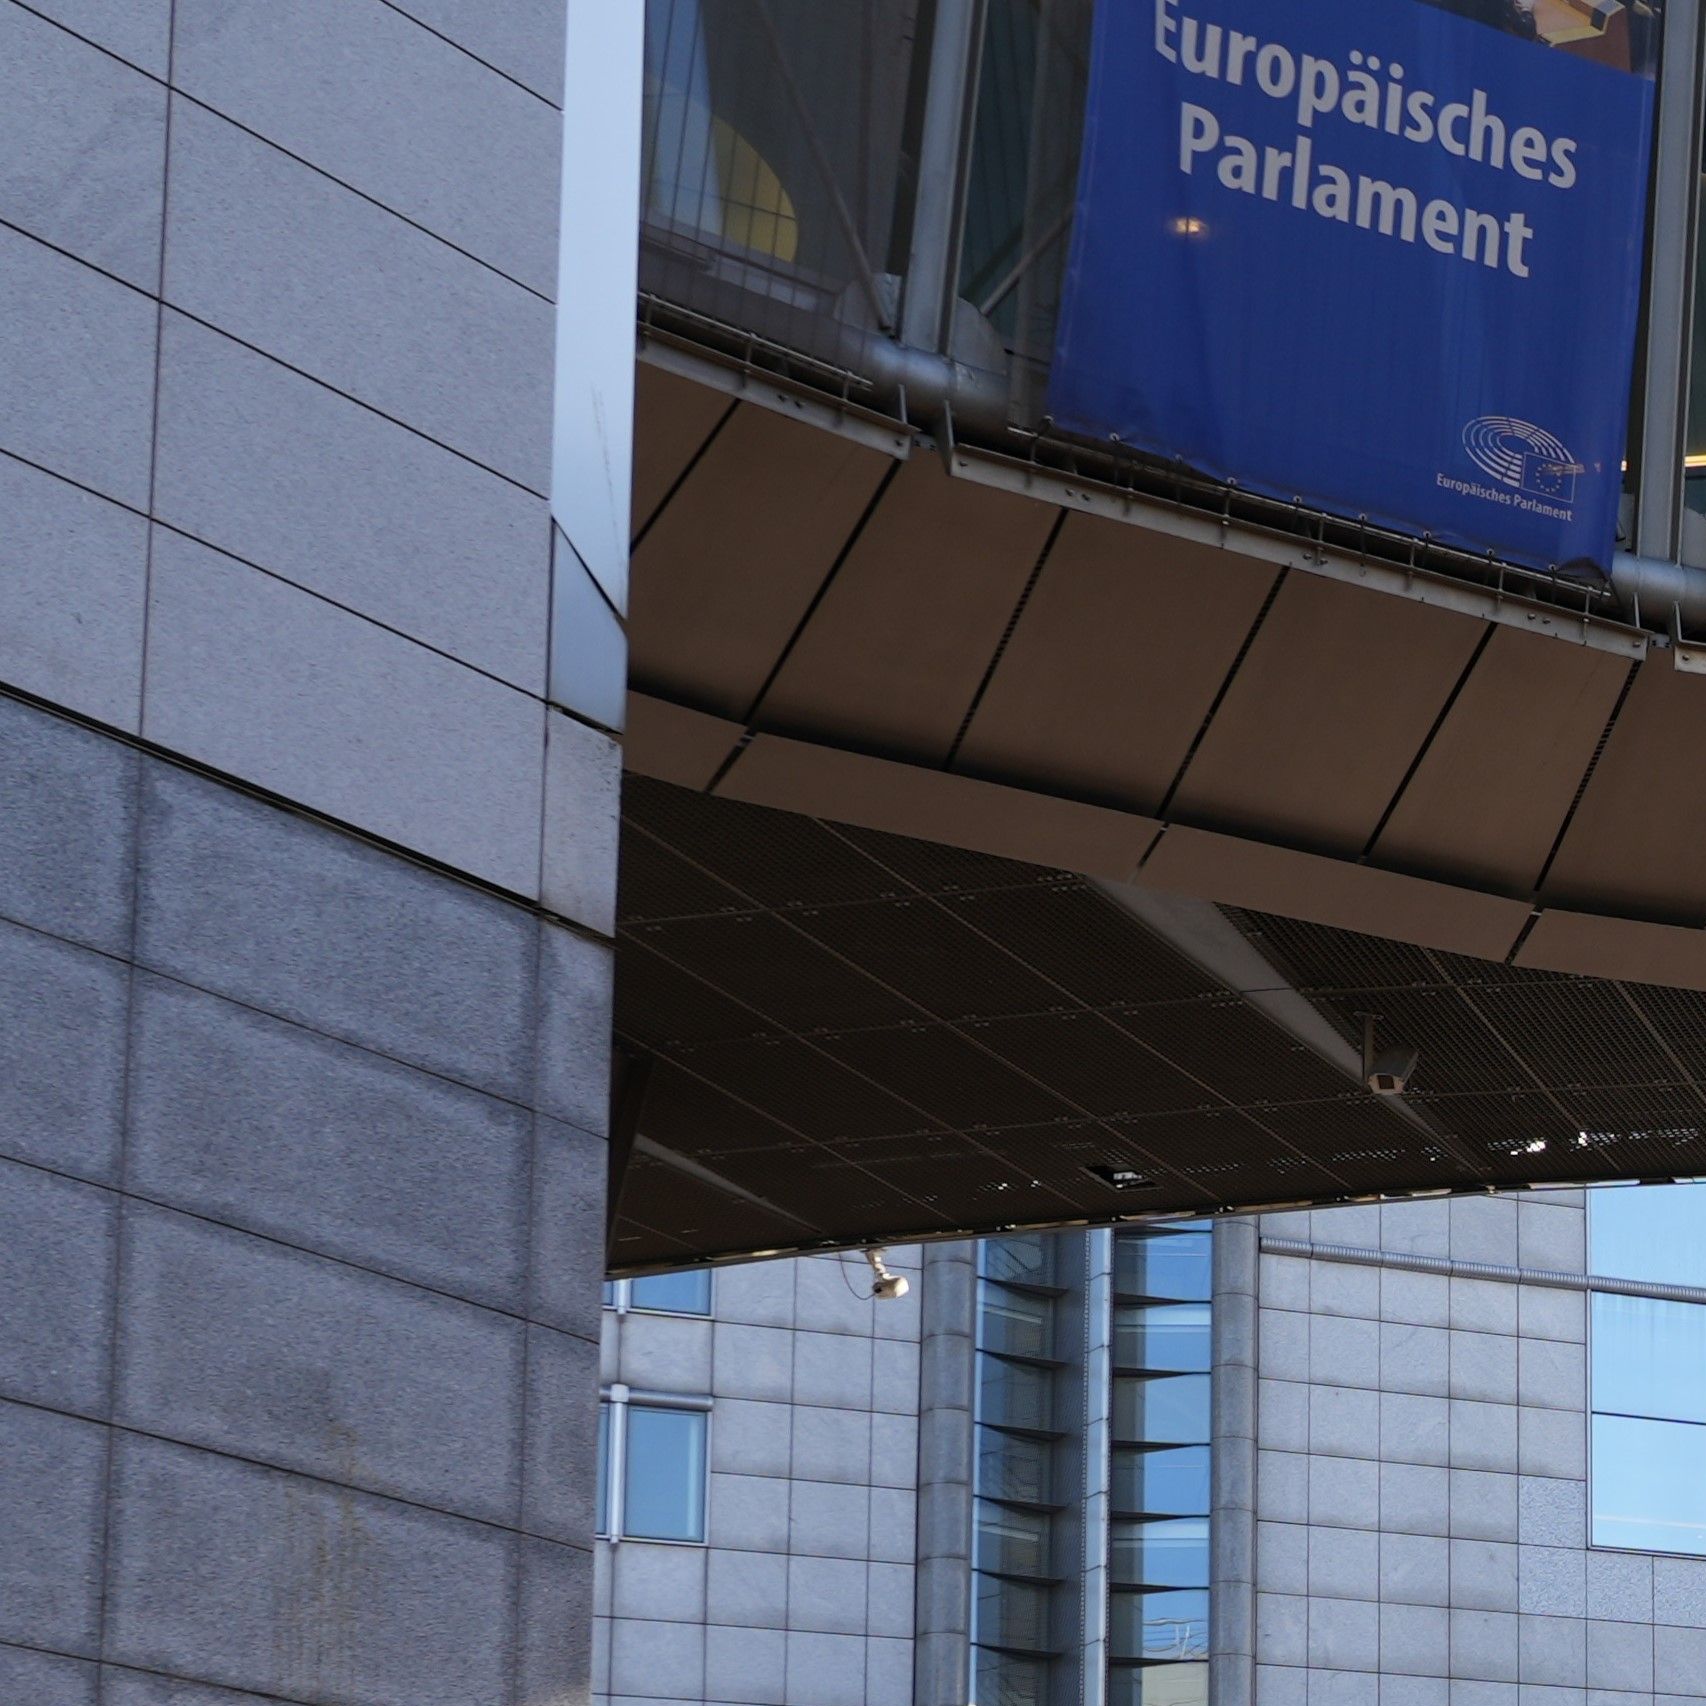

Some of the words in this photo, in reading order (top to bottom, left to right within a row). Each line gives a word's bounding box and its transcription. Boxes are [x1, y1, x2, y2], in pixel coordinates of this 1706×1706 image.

[1154, 0, 1577, 188] Europäisches
[1180, 102, 1533, 279] Parlament
[1435, 472, 1512, 506] Europäisches
[1513, 494, 1574, 522] Parlament
